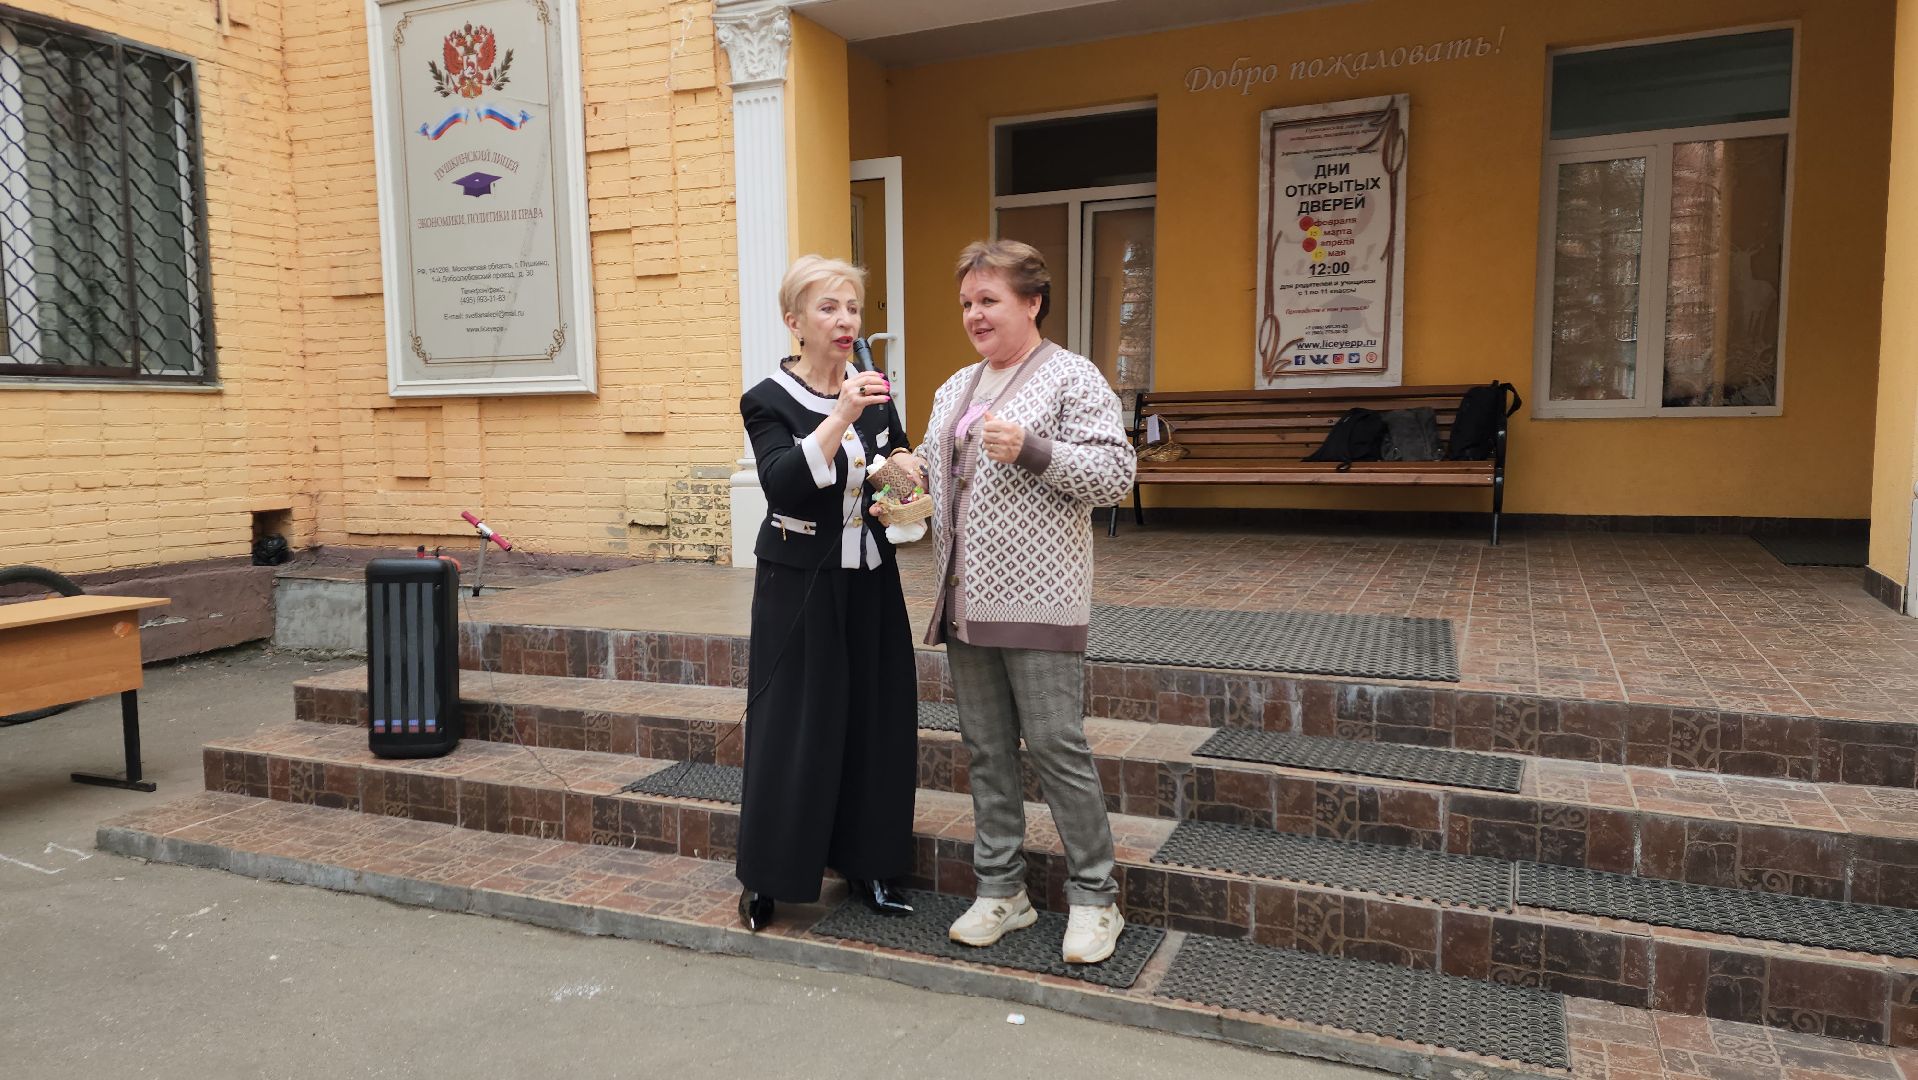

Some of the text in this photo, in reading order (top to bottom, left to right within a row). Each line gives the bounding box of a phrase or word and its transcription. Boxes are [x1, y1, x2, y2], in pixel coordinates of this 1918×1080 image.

[1184, 26, 1506, 95] Добро пожаловать!
[434, 149, 521, 181] ПУШКИНСКИЙ ЛИЦЕЙ
[1314, 162, 1350, 180] ДНИ
[1285, 177, 1381, 198] ОТКРЫТЫХ
[1297, 193, 1366, 216] ДВЕРЕЙ
[467, 209, 510, 225] ПОЛИТИКИ
[511, 210, 518, 222] И
[518, 207, 544, 221] ПРАВА
[1323, 229, 1352, 237] марта
[1320, 238, 1355, 248] апреля
[1309, 261, 1350, 276] 12:00
[1294, 281, 1333, 289] родителей
[1296, 340, 1377, 350] www.liceyepp.ru
